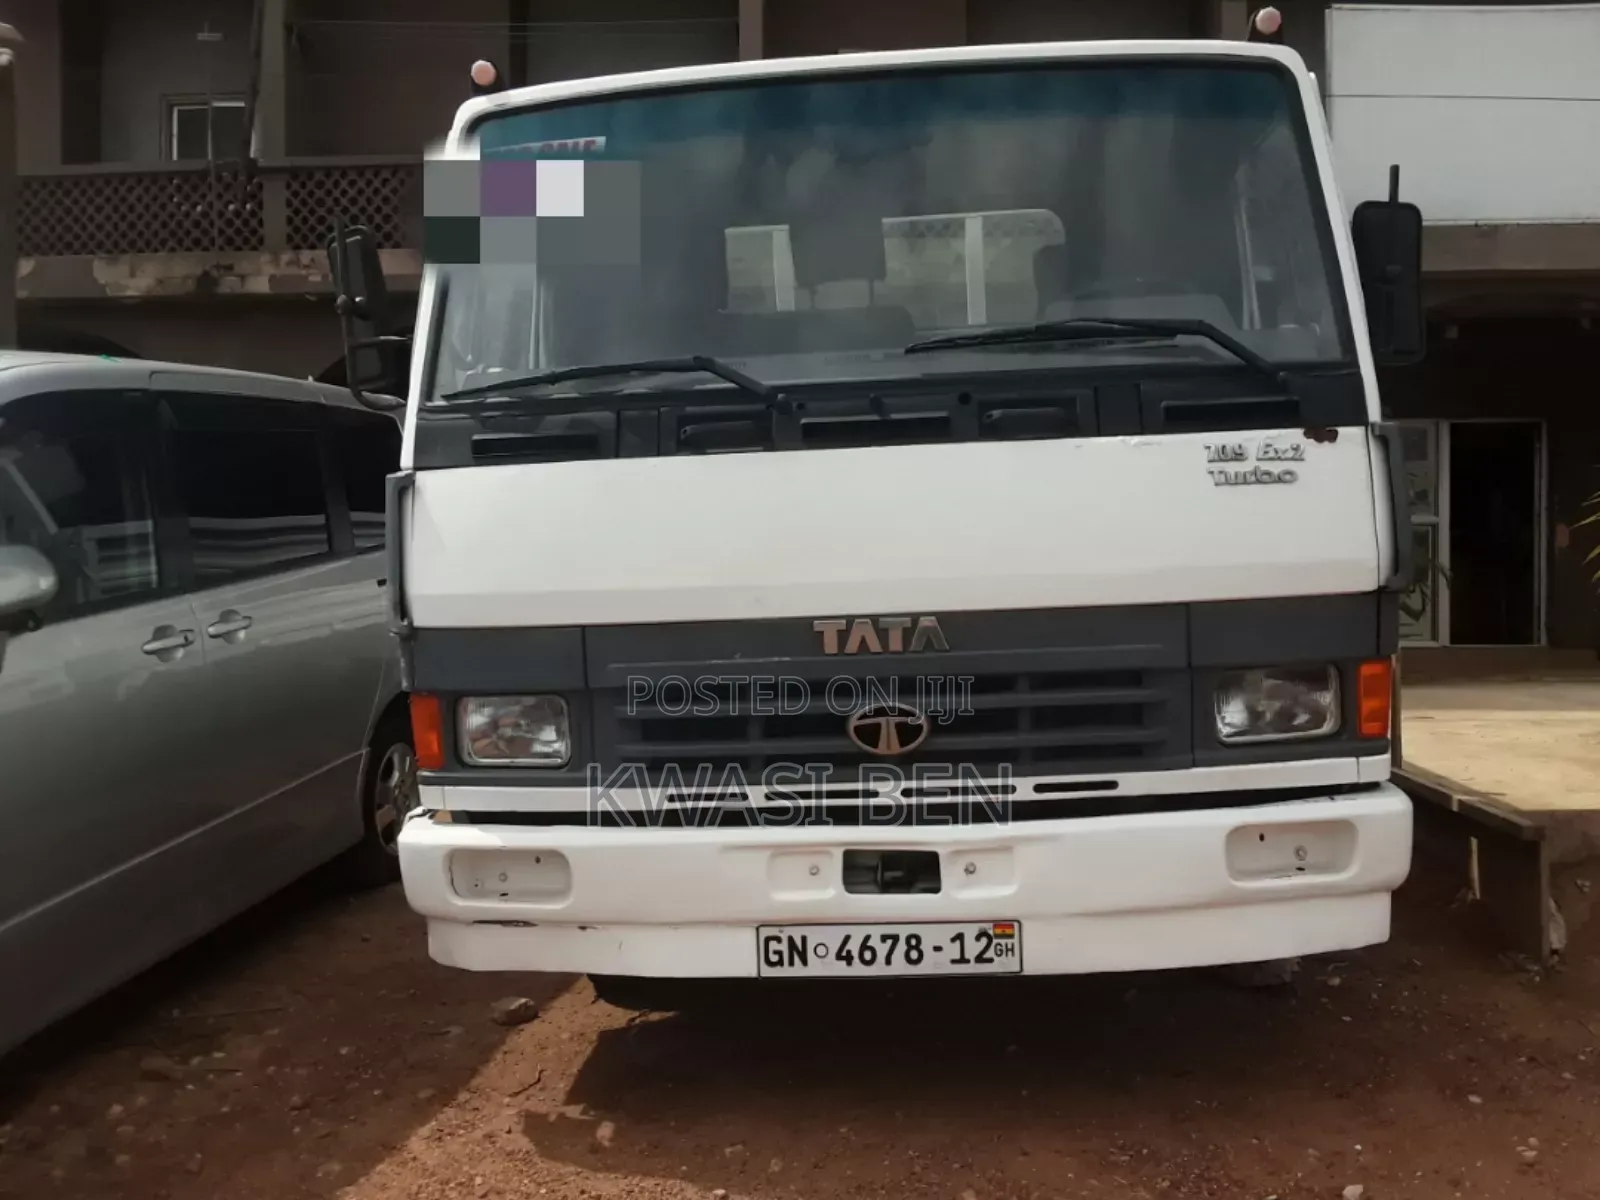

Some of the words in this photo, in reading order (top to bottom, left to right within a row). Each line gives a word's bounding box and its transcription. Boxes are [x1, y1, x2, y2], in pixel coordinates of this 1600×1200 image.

[1204, 443, 1248, 462] 709
[1207, 464, 1299, 486] Turbo
[813, 616, 950, 655] TATA
[763, 934, 809, 968] GN
[993, 941, 1016, 958] GH
